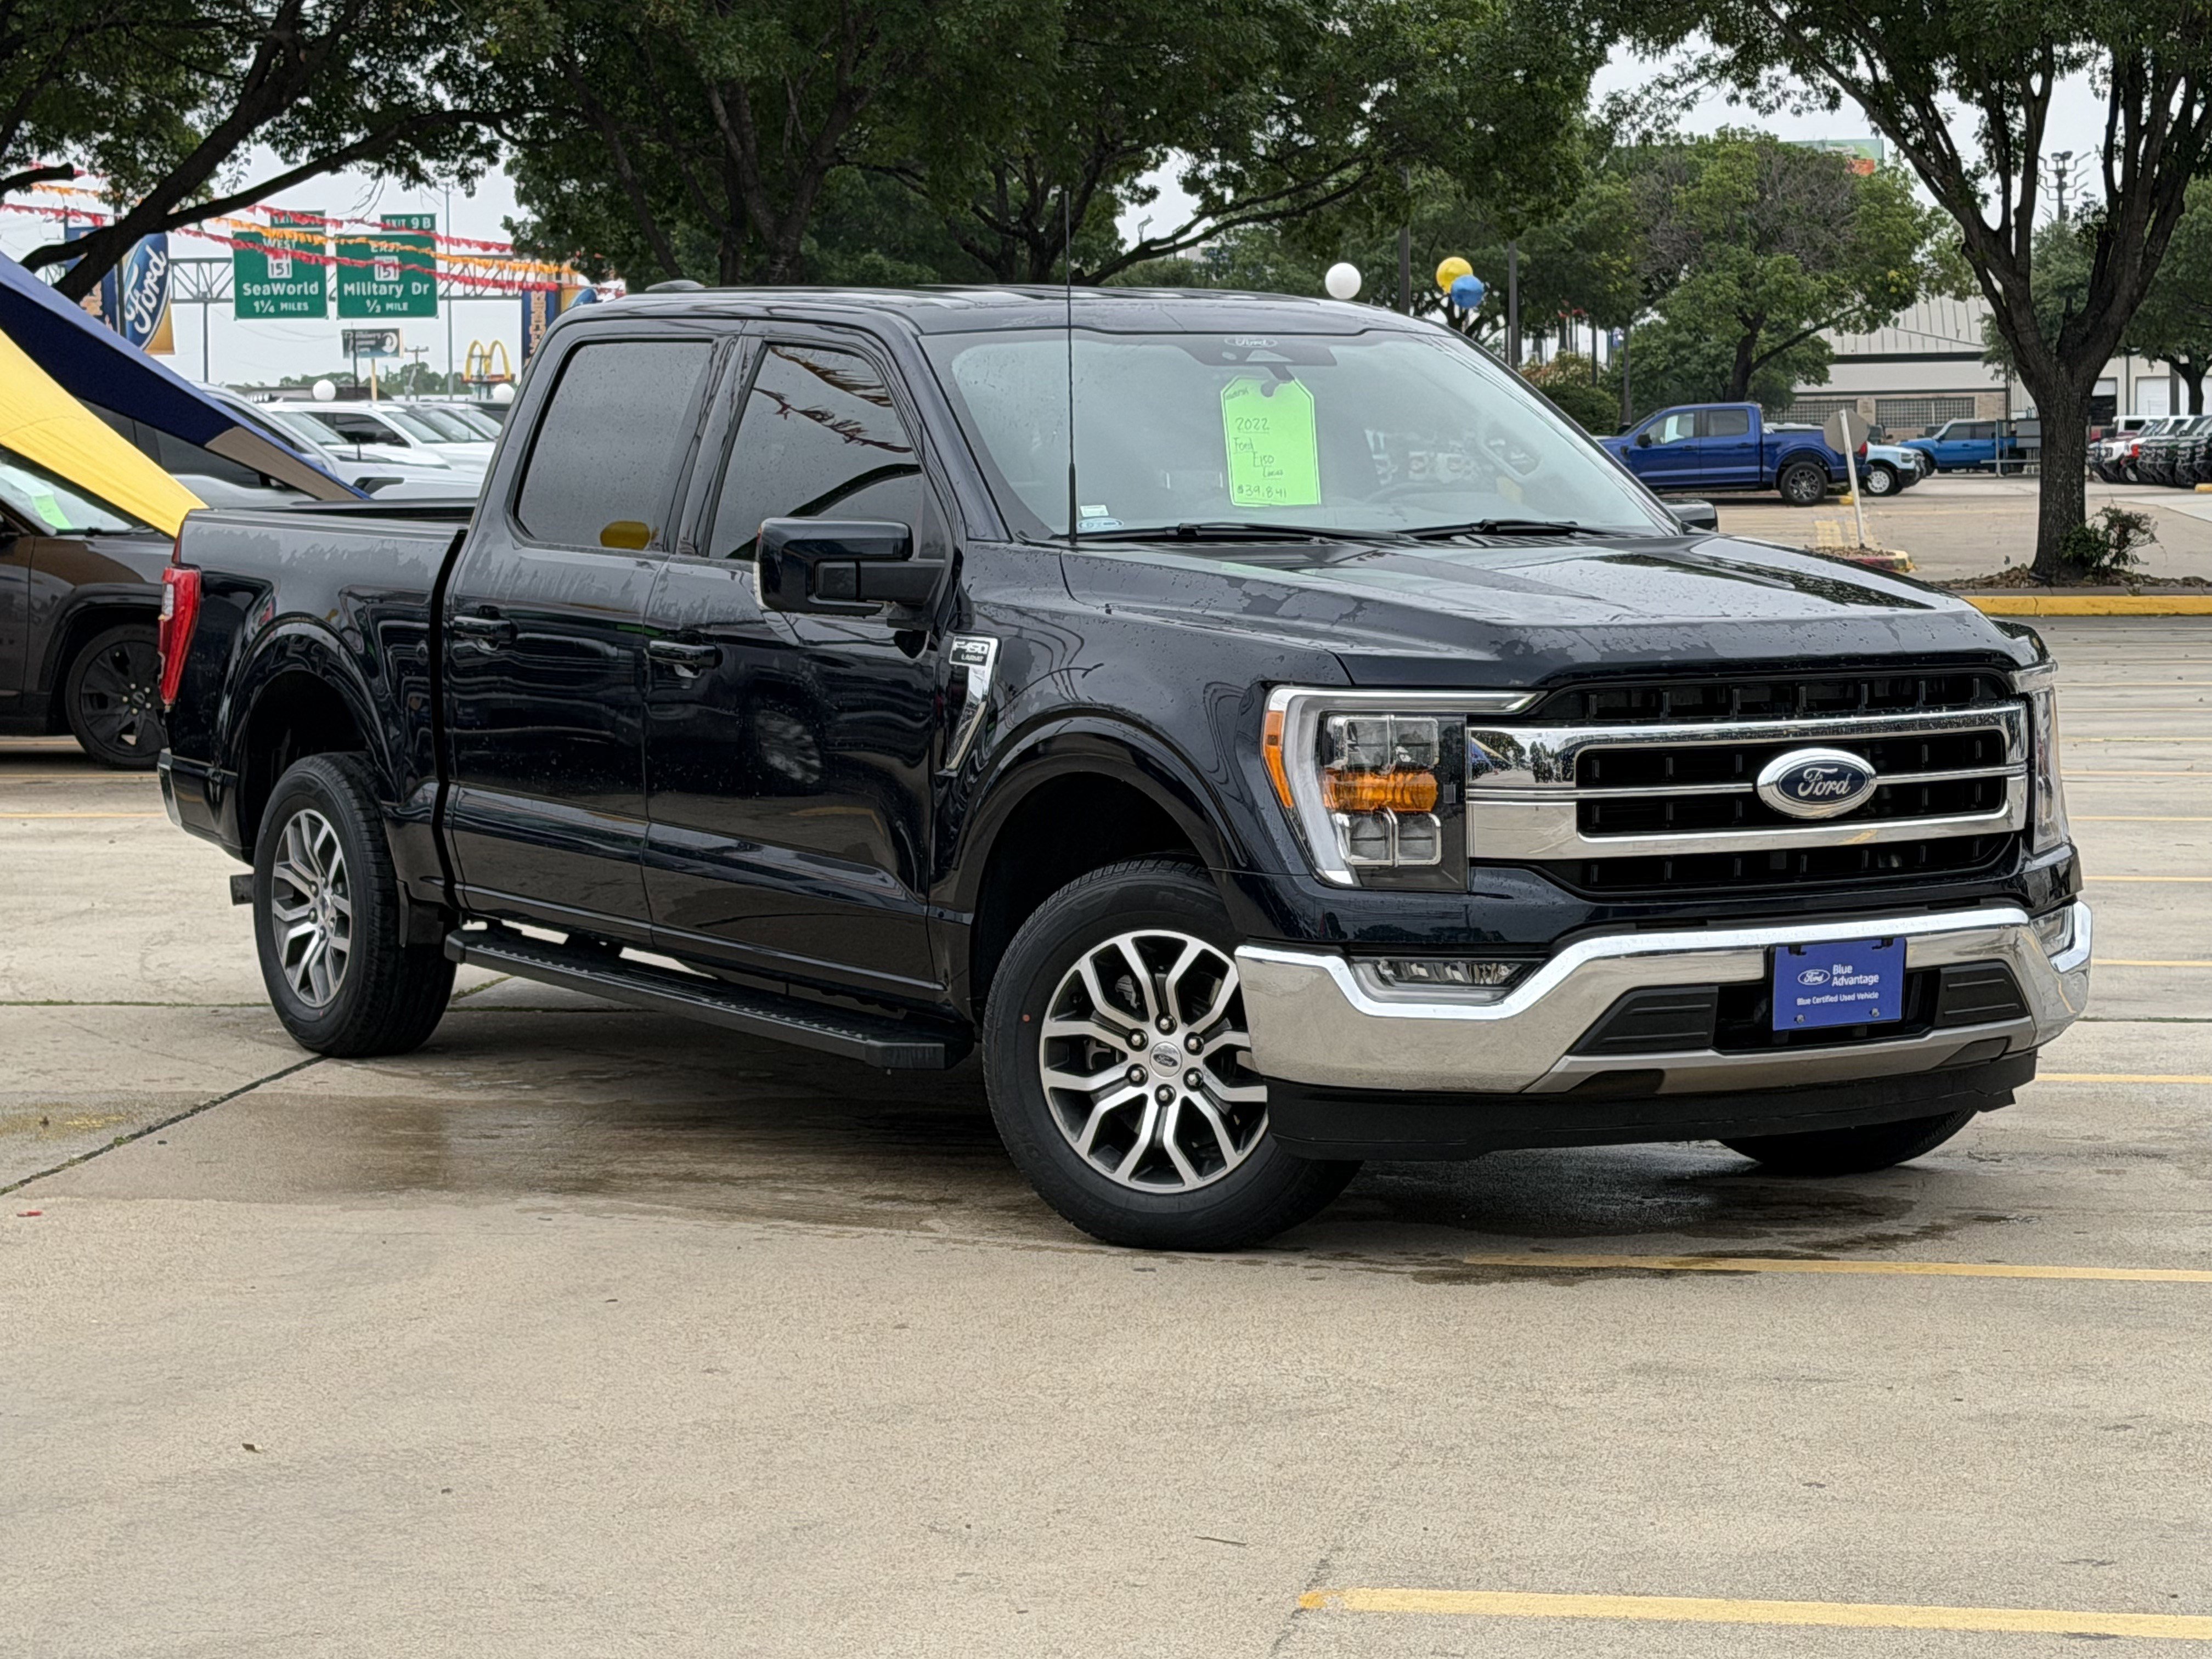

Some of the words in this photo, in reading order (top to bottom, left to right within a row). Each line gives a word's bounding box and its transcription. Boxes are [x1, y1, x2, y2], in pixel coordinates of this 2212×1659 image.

[270, 262, 290, 276] 151
[377, 266, 397, 279] 151
[124, 245, 167, 334] Ford
[242, 281, 319, 296] SeaWorld
[343, 281, 404, 298] Military
[411, 281, 430, 295] Dr
[280, 302, 309, 311] MILES
[386, 302, 408, 311] MILE
[1235, 417, 1270, 431] 2022
[1797, 768, 1852, 797] Ford
[1832, 964, 1853, 975] Blue
[1803, 971, 1825, 983] Ford
[1831, 974, 1880, 987] Advantage
[1797, 997, 1812, 1006] Blue
[1812, 994, 1838, 1005] Certified
[1839, 992, 1856, 1002] Used
[1857, 991, 1879, 1000] Vehicle
